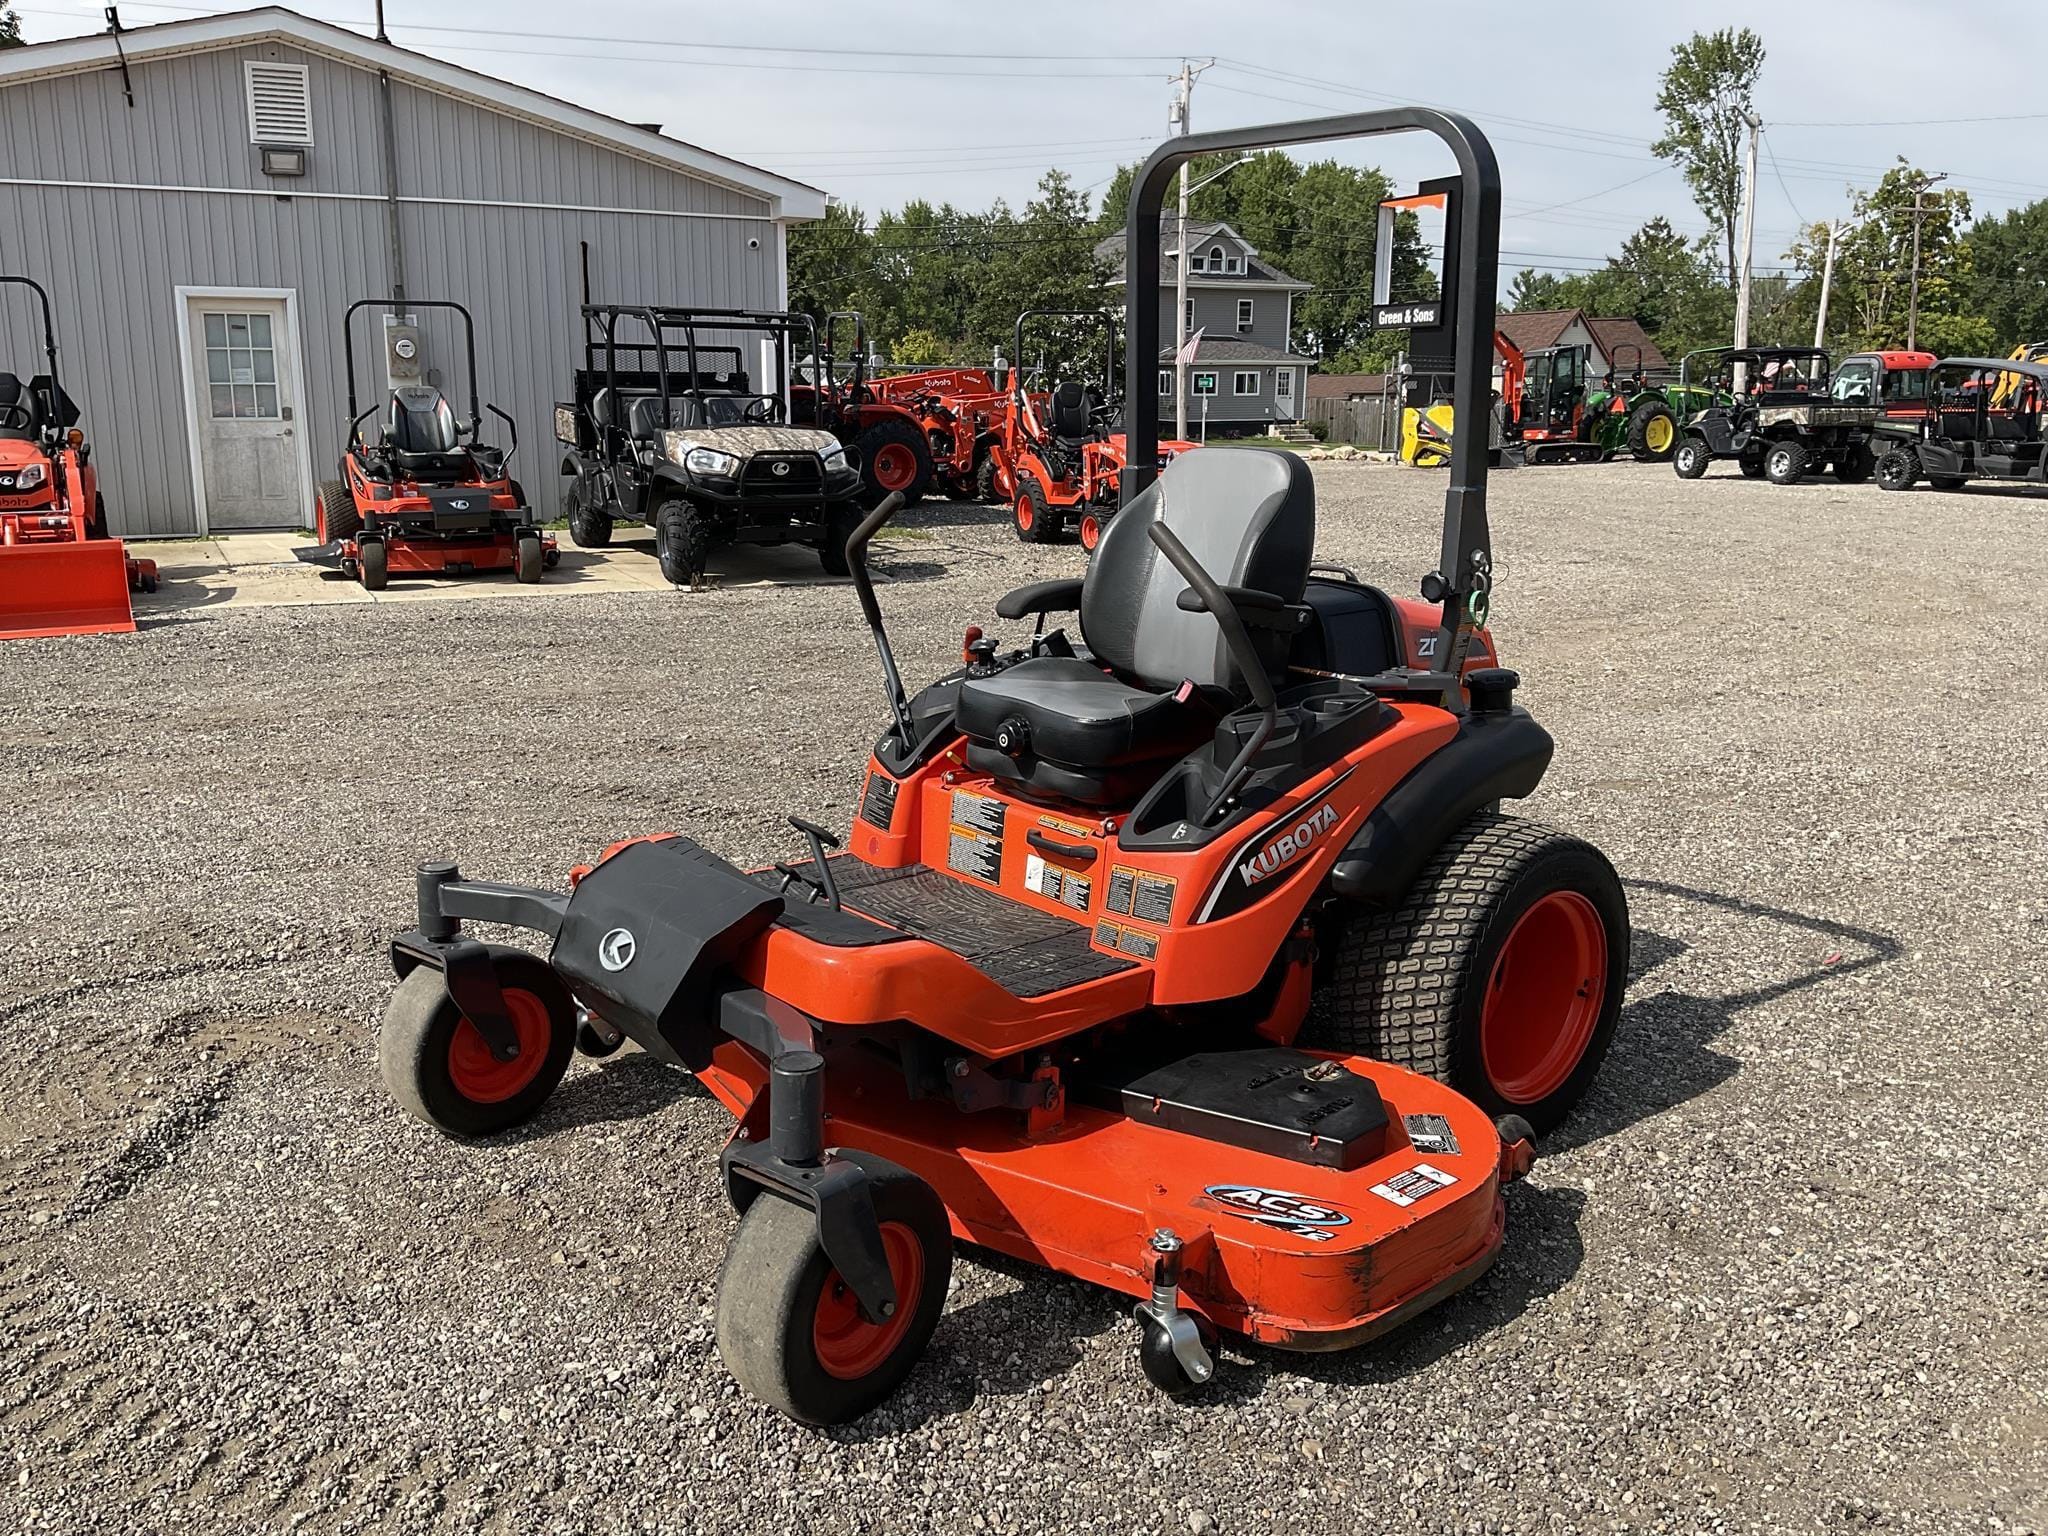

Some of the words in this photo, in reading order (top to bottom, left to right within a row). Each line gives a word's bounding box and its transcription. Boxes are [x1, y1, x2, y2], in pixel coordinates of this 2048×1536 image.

[1378, 311, 1402, 325] Green
[1404, 309, 1412, 323] &
[1413, 308, 1434, 322] Sons
[925, 379, 951, 387] Kubota
[1239, 803, 1339, 887] KUBOTA
[1221, 1190, 1334, 1220] ACS
[1292, 1225, 1335, 1241] 72
